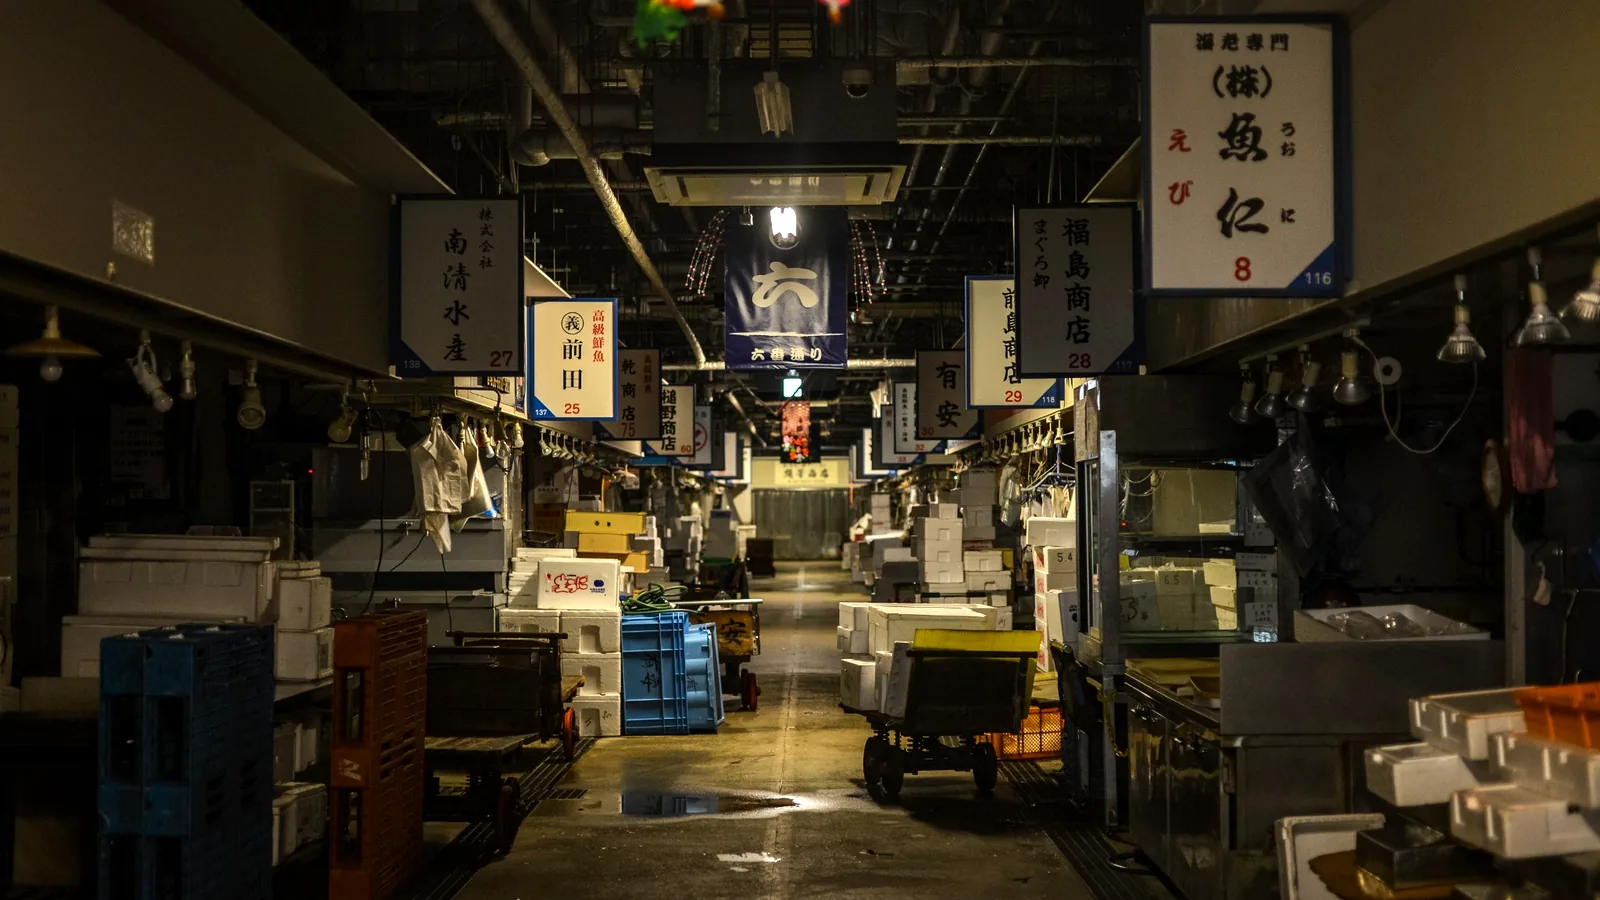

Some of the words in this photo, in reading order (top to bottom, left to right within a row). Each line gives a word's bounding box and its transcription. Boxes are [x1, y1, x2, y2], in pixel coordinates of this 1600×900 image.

[1196, 32, 1289, 52] 海老専門
[1213, 64, 1272, 98] (株)
[1168, 129, 1193, 205] えび
[1217, 112, 1269, 238] 魚仁
[478, 207, 494, 269] 株式会社
[1033, 219, 1050, 289] まぐろ卸
[1234, 256, 1252, 281] 8
[1305, 271, 1332, 284] 116
[752, 261, 819, 308] 六
[1062, 217, 1091, 344] 福島商店
[443, 228, 470, 361] 南清水産
[592, 310, 604, 362] 高級鮮魚
[490, 351, 513, 367] 27
[562, 338, 583, 390] 前田
[751, 347, 823, 361] 六番通り
[1069, 353, 1091, 369] 28
[403, 360, 421, 369] 138
[1116, 360, 1133, 369] 117
[935, 361, 961, 428] 有安
[1005, 390, 1022, 402] 29
[564, 403, 580, 415] 25
[621, 422, 636, 438] 75
[921, 426, 934, 436] 30
[681, 444, 692, 453] 60
[1057, 552, 1073, 563] 5.4
